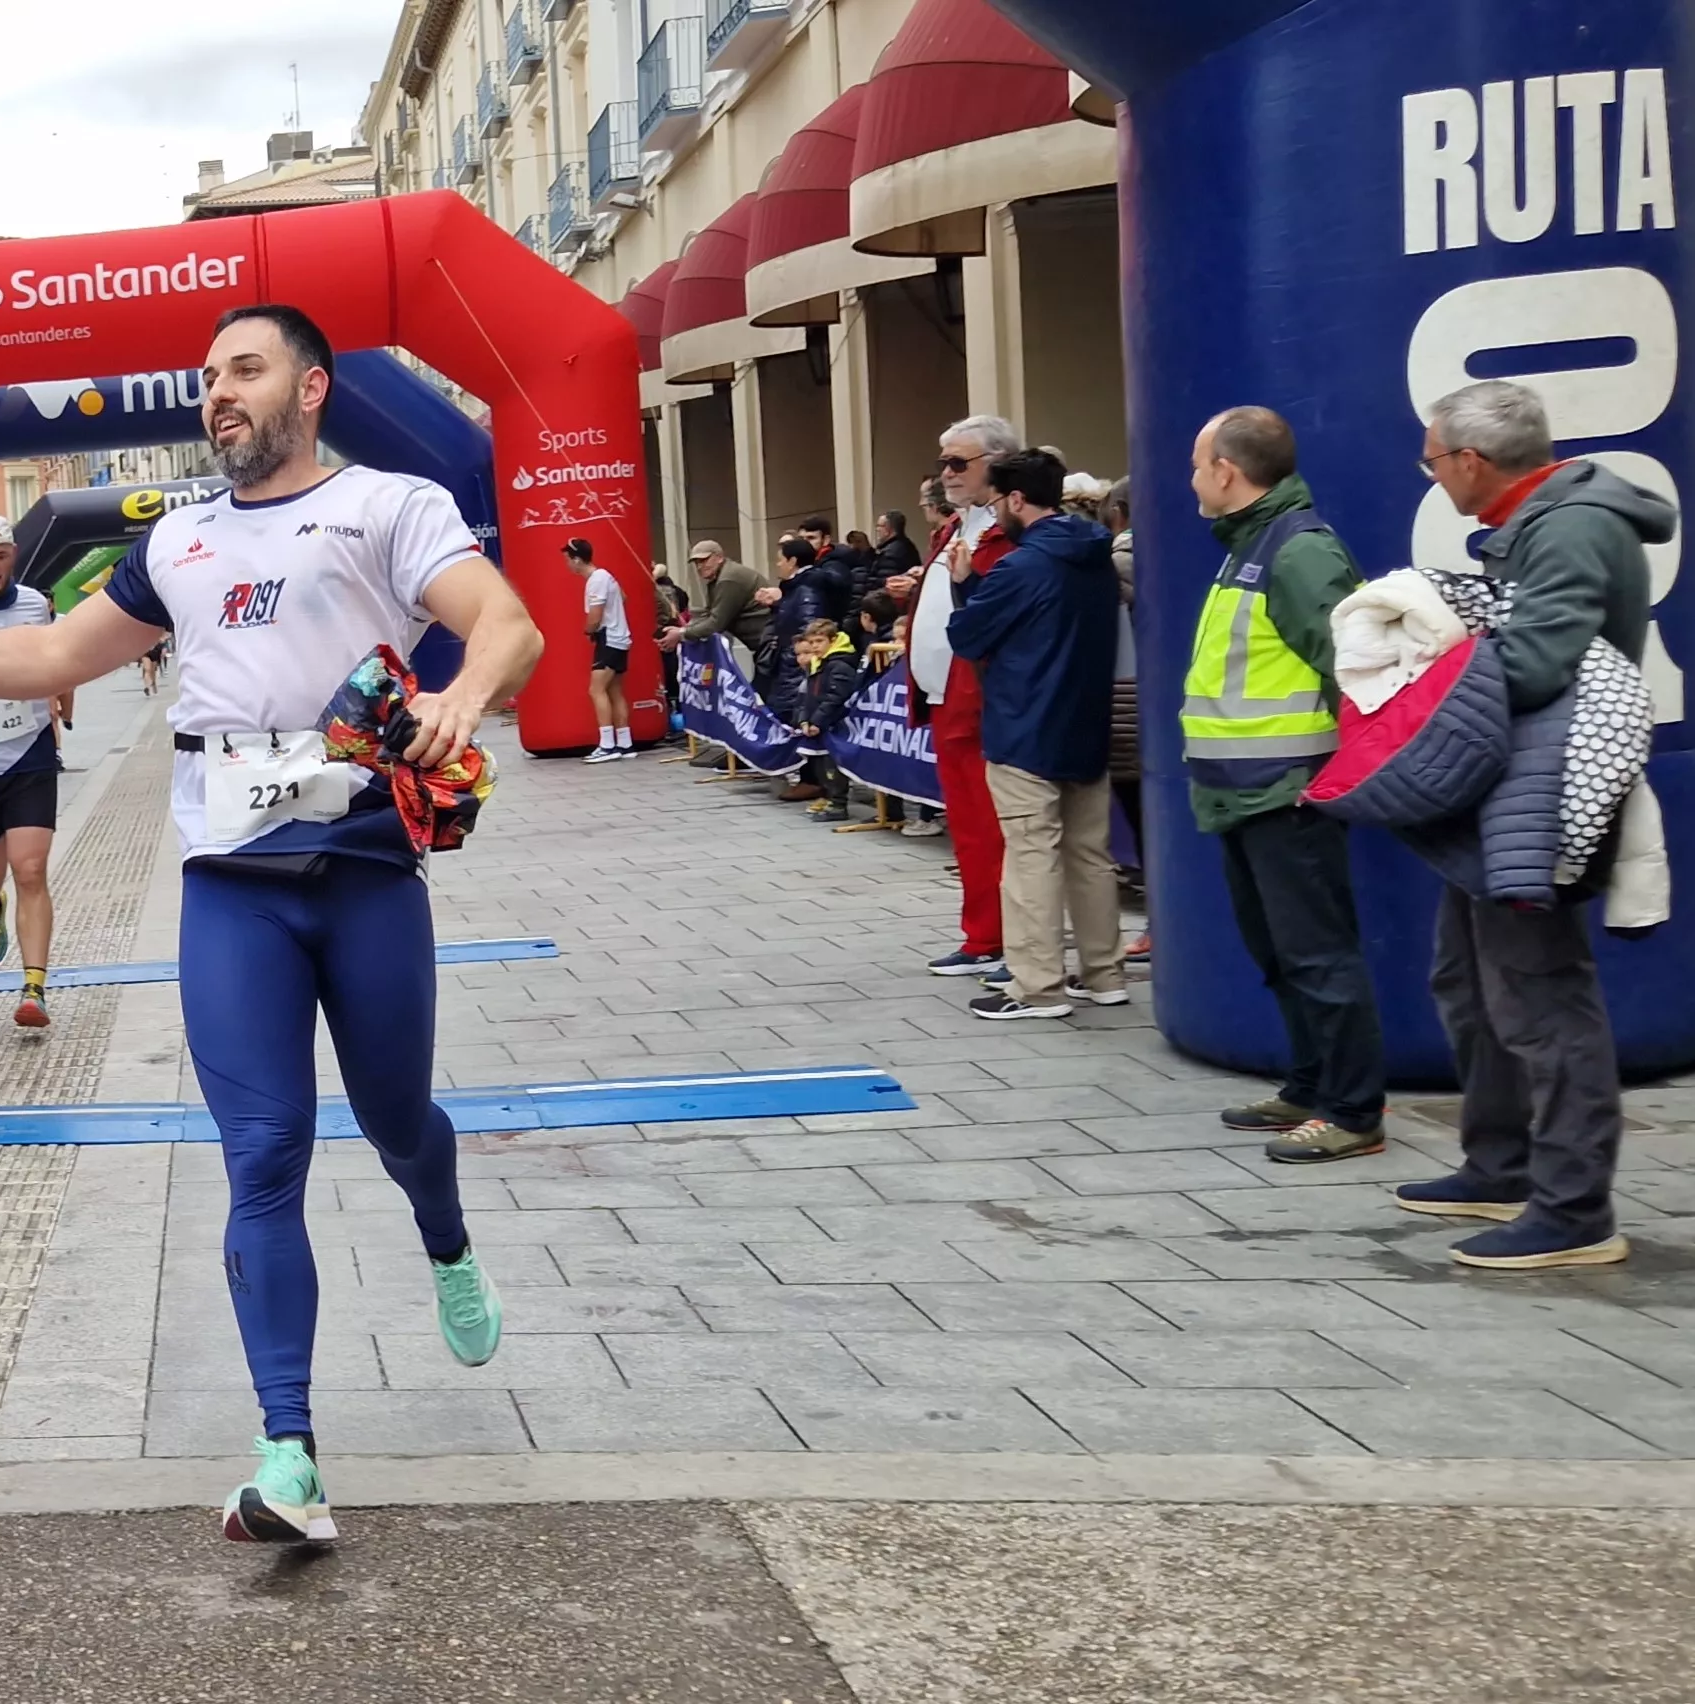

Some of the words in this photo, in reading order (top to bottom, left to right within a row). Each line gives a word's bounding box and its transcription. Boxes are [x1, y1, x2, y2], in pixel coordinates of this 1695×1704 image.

[1402, 67, 1676, 255] RUTA
[11, 252, 245, 310] Santander
[539, 427, 607, 453] Sports
[535, 459, 636, 486] Santander
[324, 524, 365, 540] mupol
[172, 550, 216, 570] Santander
[2, 715, 23, 730] 422
[249, 781, 300, 810] 221
